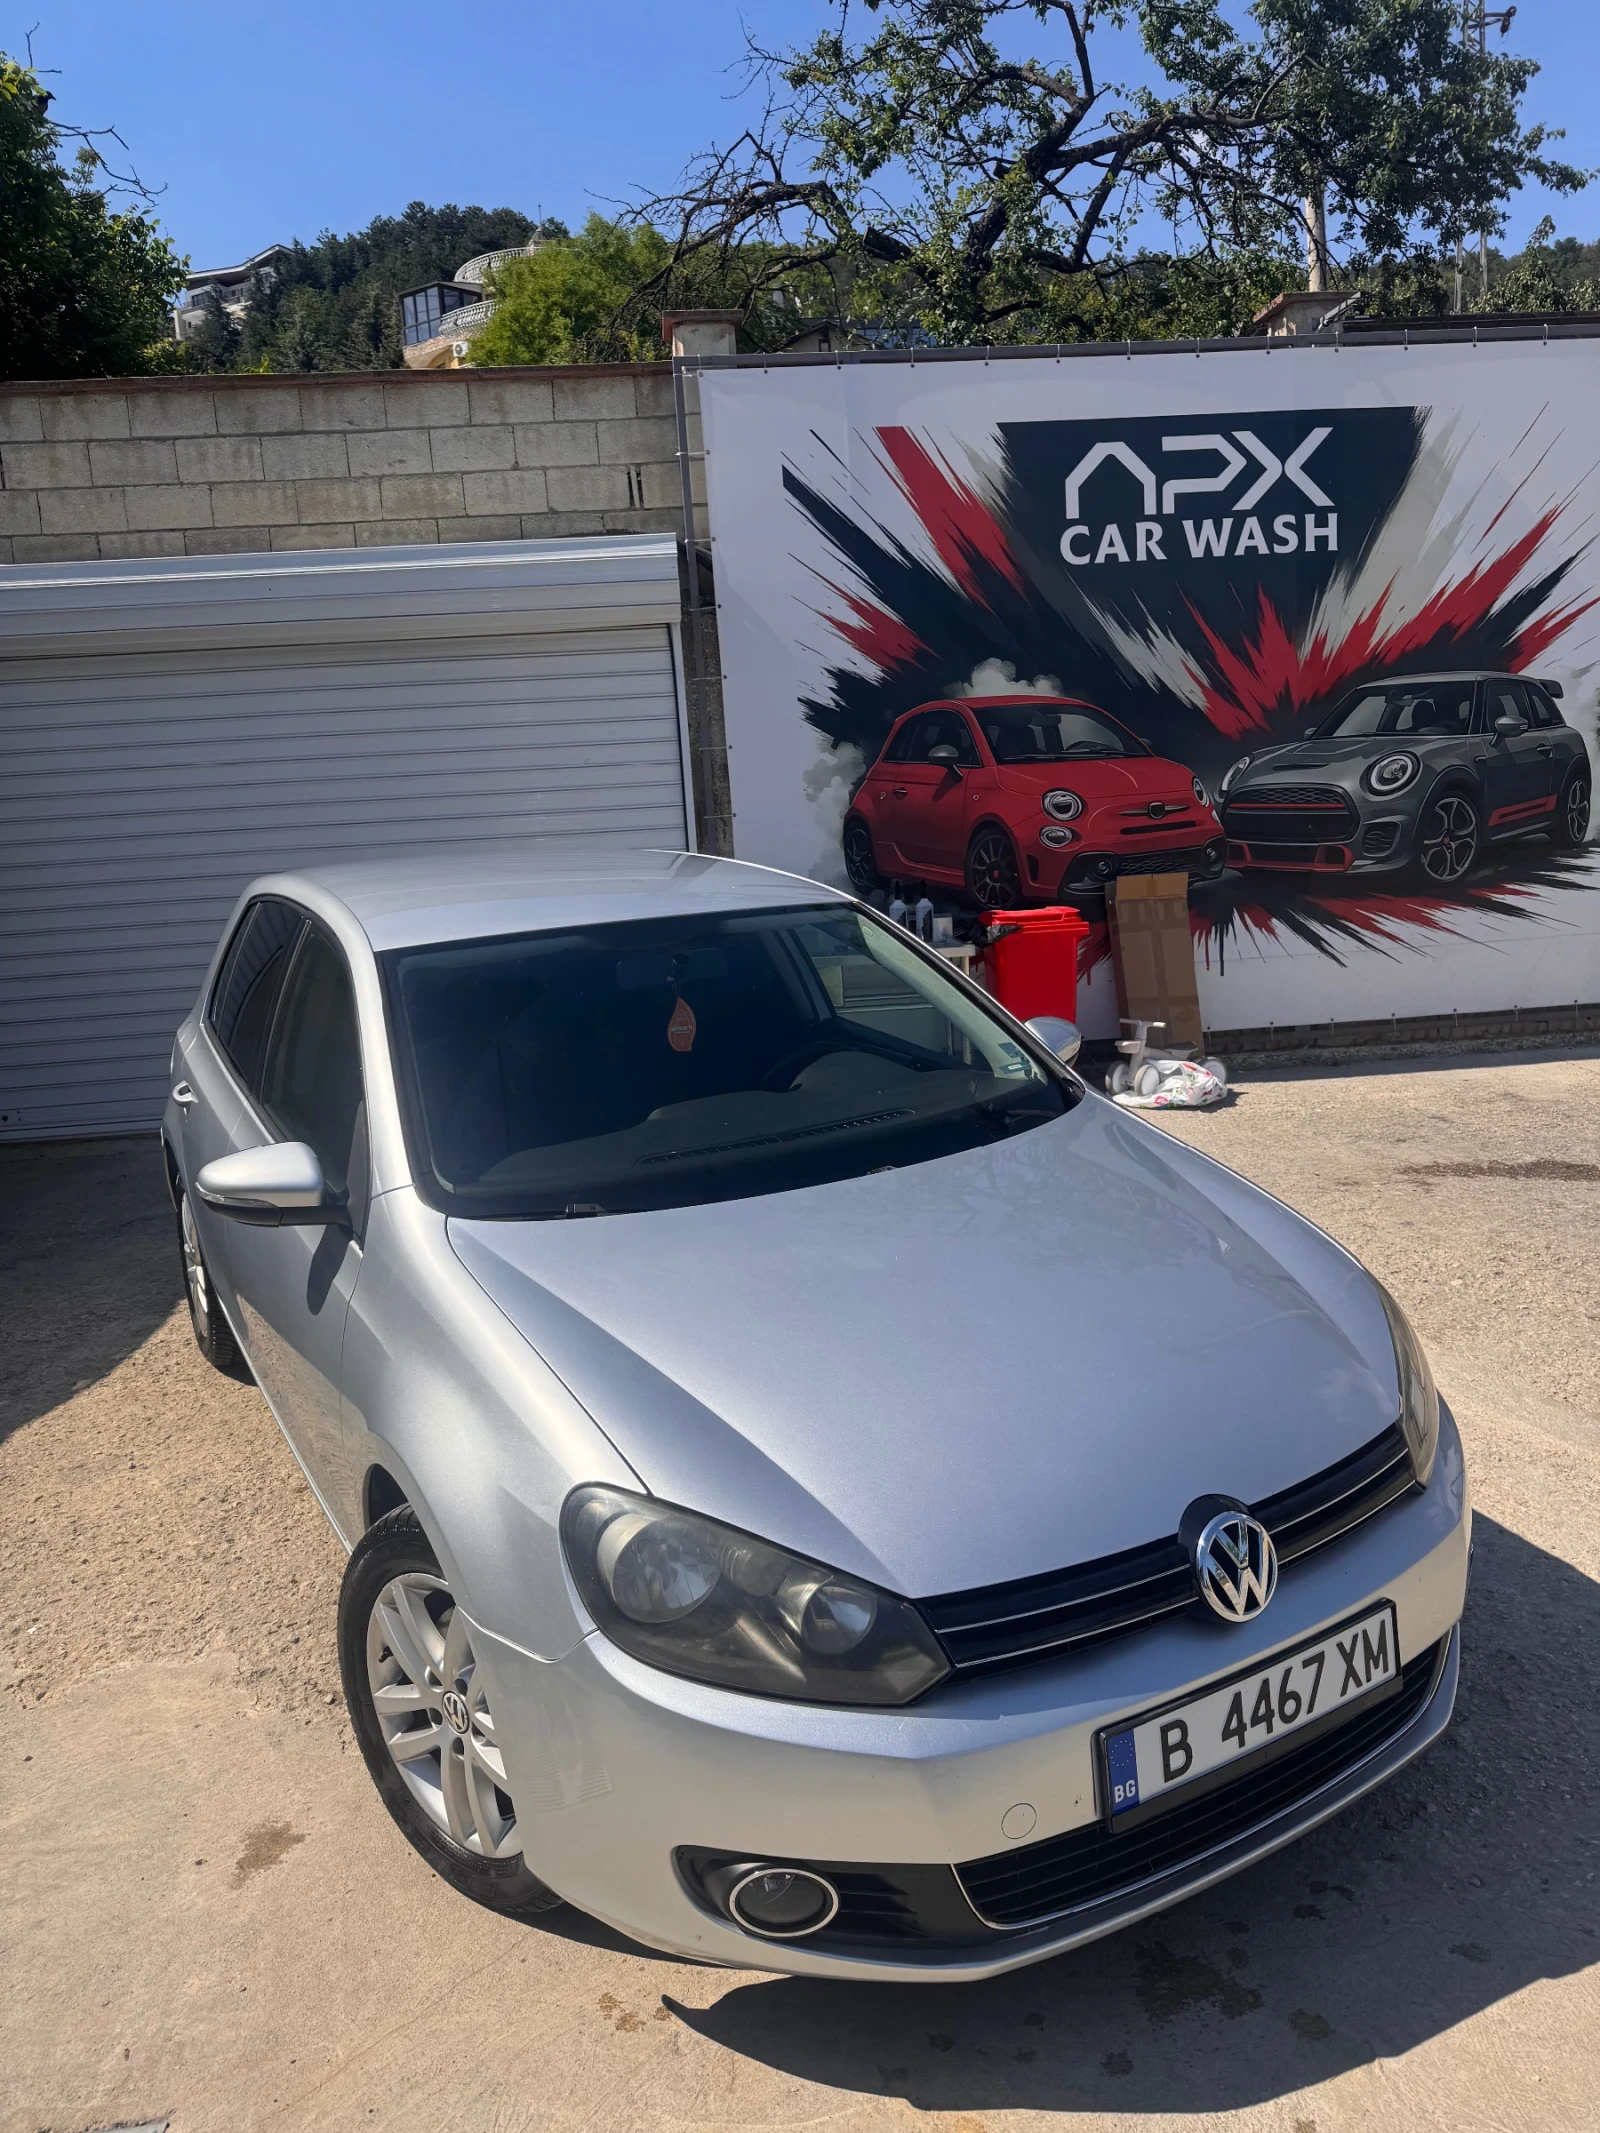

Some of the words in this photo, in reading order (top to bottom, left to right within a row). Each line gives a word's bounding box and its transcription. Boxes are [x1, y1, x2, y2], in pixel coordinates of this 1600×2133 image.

[1065, 427, 1336, 519] APX
[1060, 521, 1167, 565] CAR
[1182, 513, 1339, 558] WASH
[1199, 1513, 1276, 1620] VW
[1160, 1719, 1193, 1783] B
[1221, 1651, 1326, 1749] 4467
[1336, 1619, 1389, 1697] XM
[1114, 1779, 1136, 1803] BG
